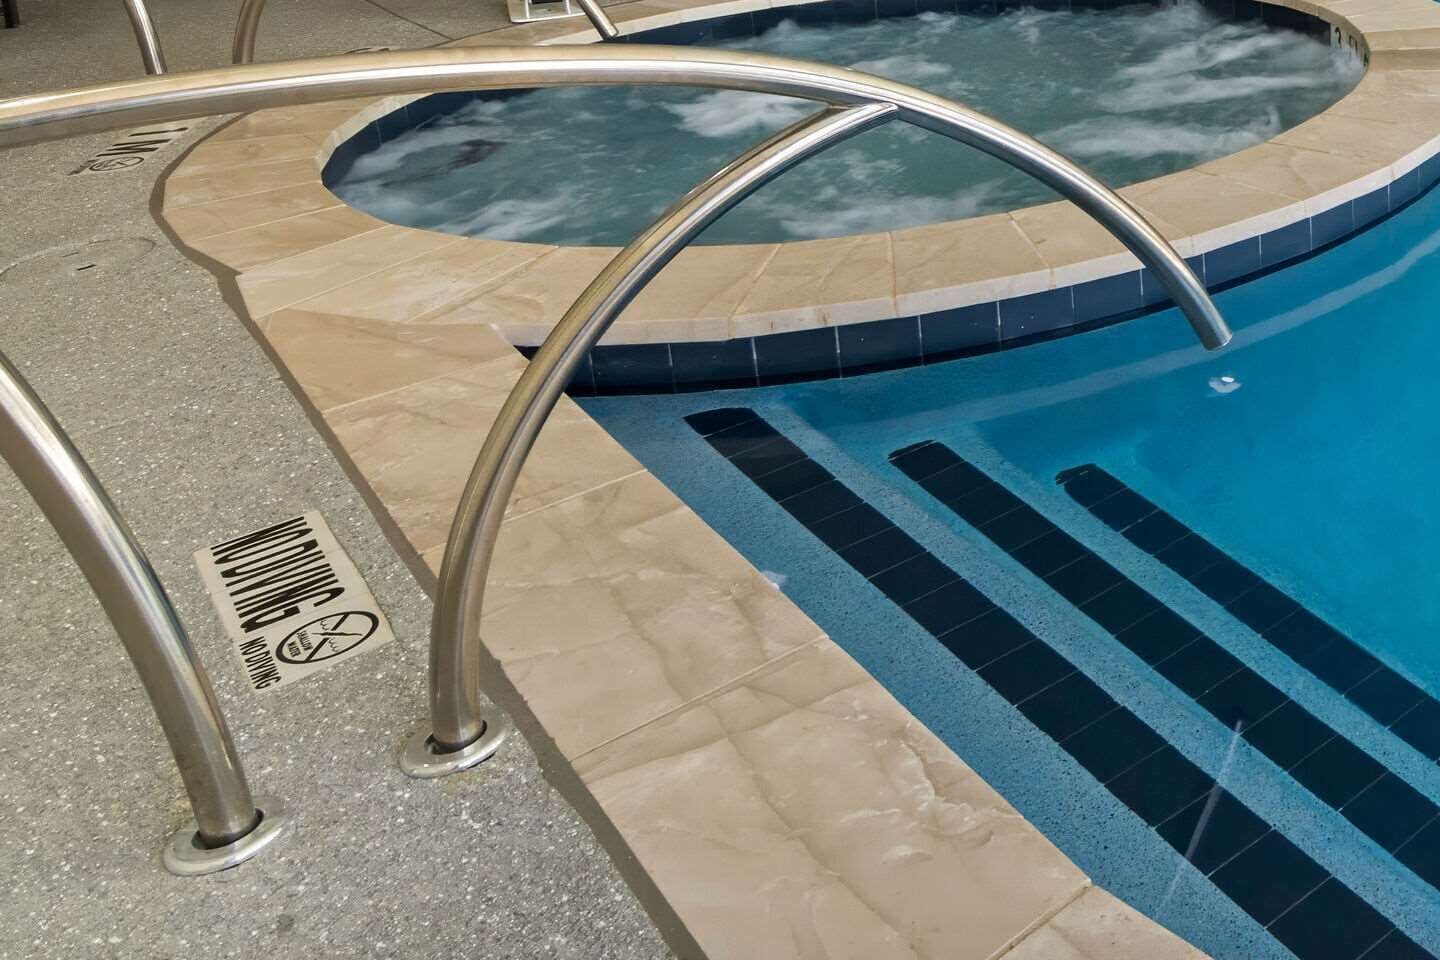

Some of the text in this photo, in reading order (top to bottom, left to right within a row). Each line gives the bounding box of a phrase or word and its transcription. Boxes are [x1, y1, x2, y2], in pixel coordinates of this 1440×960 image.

[210, 516, 345, 634] NO DIVING
[239, 636, 282, 690] NO DIVING
